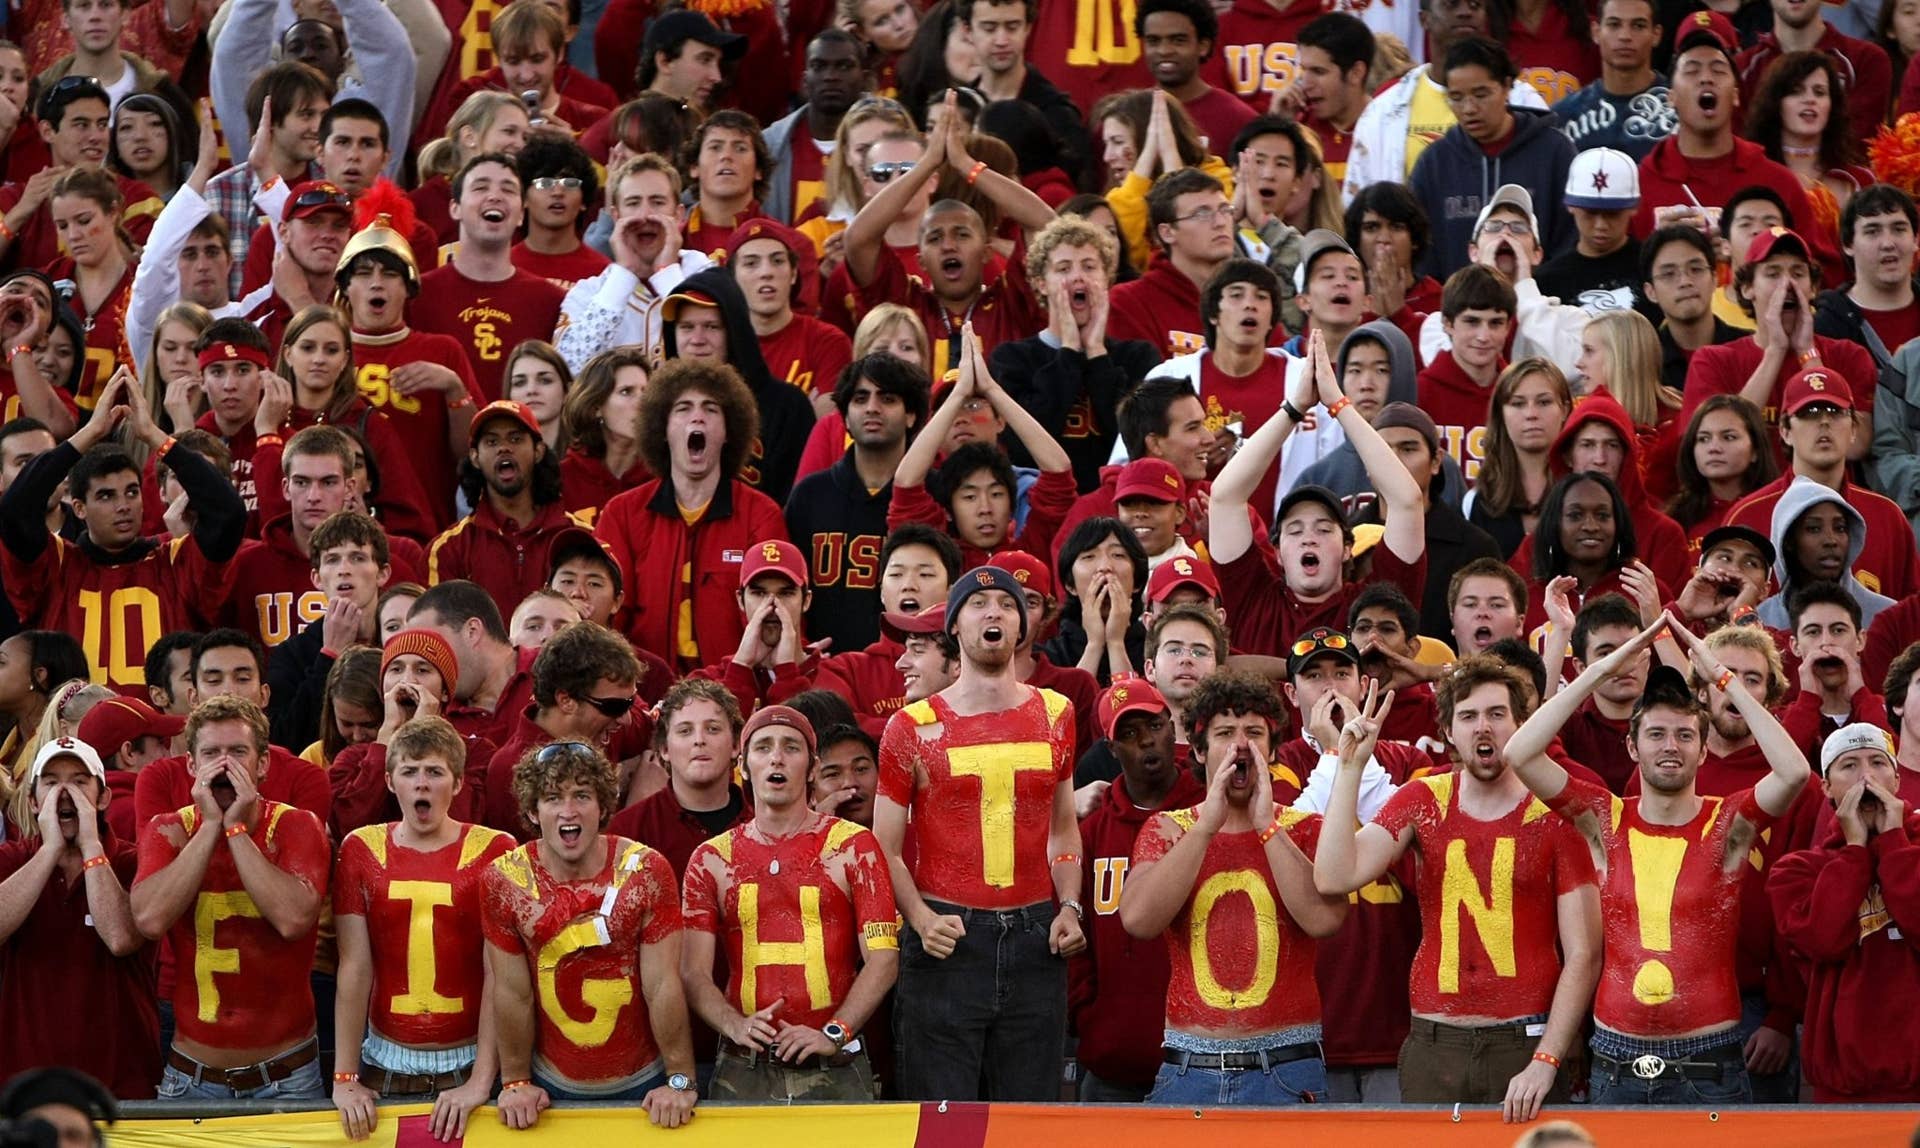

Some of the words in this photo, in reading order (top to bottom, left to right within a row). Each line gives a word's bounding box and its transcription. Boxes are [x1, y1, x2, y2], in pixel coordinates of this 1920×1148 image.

[1224, 42, 1299, 97] US
[458, 307, 512, 326] Trojans
[473, 323, 502, 361] SC
[353, 363, 421, 415] SC
[763, 543, 781, 562] SC
[812, 532, 884, 589] US
[79, 587, 163, 687] 10
[945, 742, 1053, 889] T
[195, 892, 262, 1022] F
[388, 880, 465, 1016] I
[739, 882, 832, 1015] H
[1190, 868, 1279, 1009] O
[1438, 838, 1517, 994] N
[1628, 834, 1688, 1006] !
[538, 918, 633, 1047] G
[1638, 1057, 1659, 1076] USC
